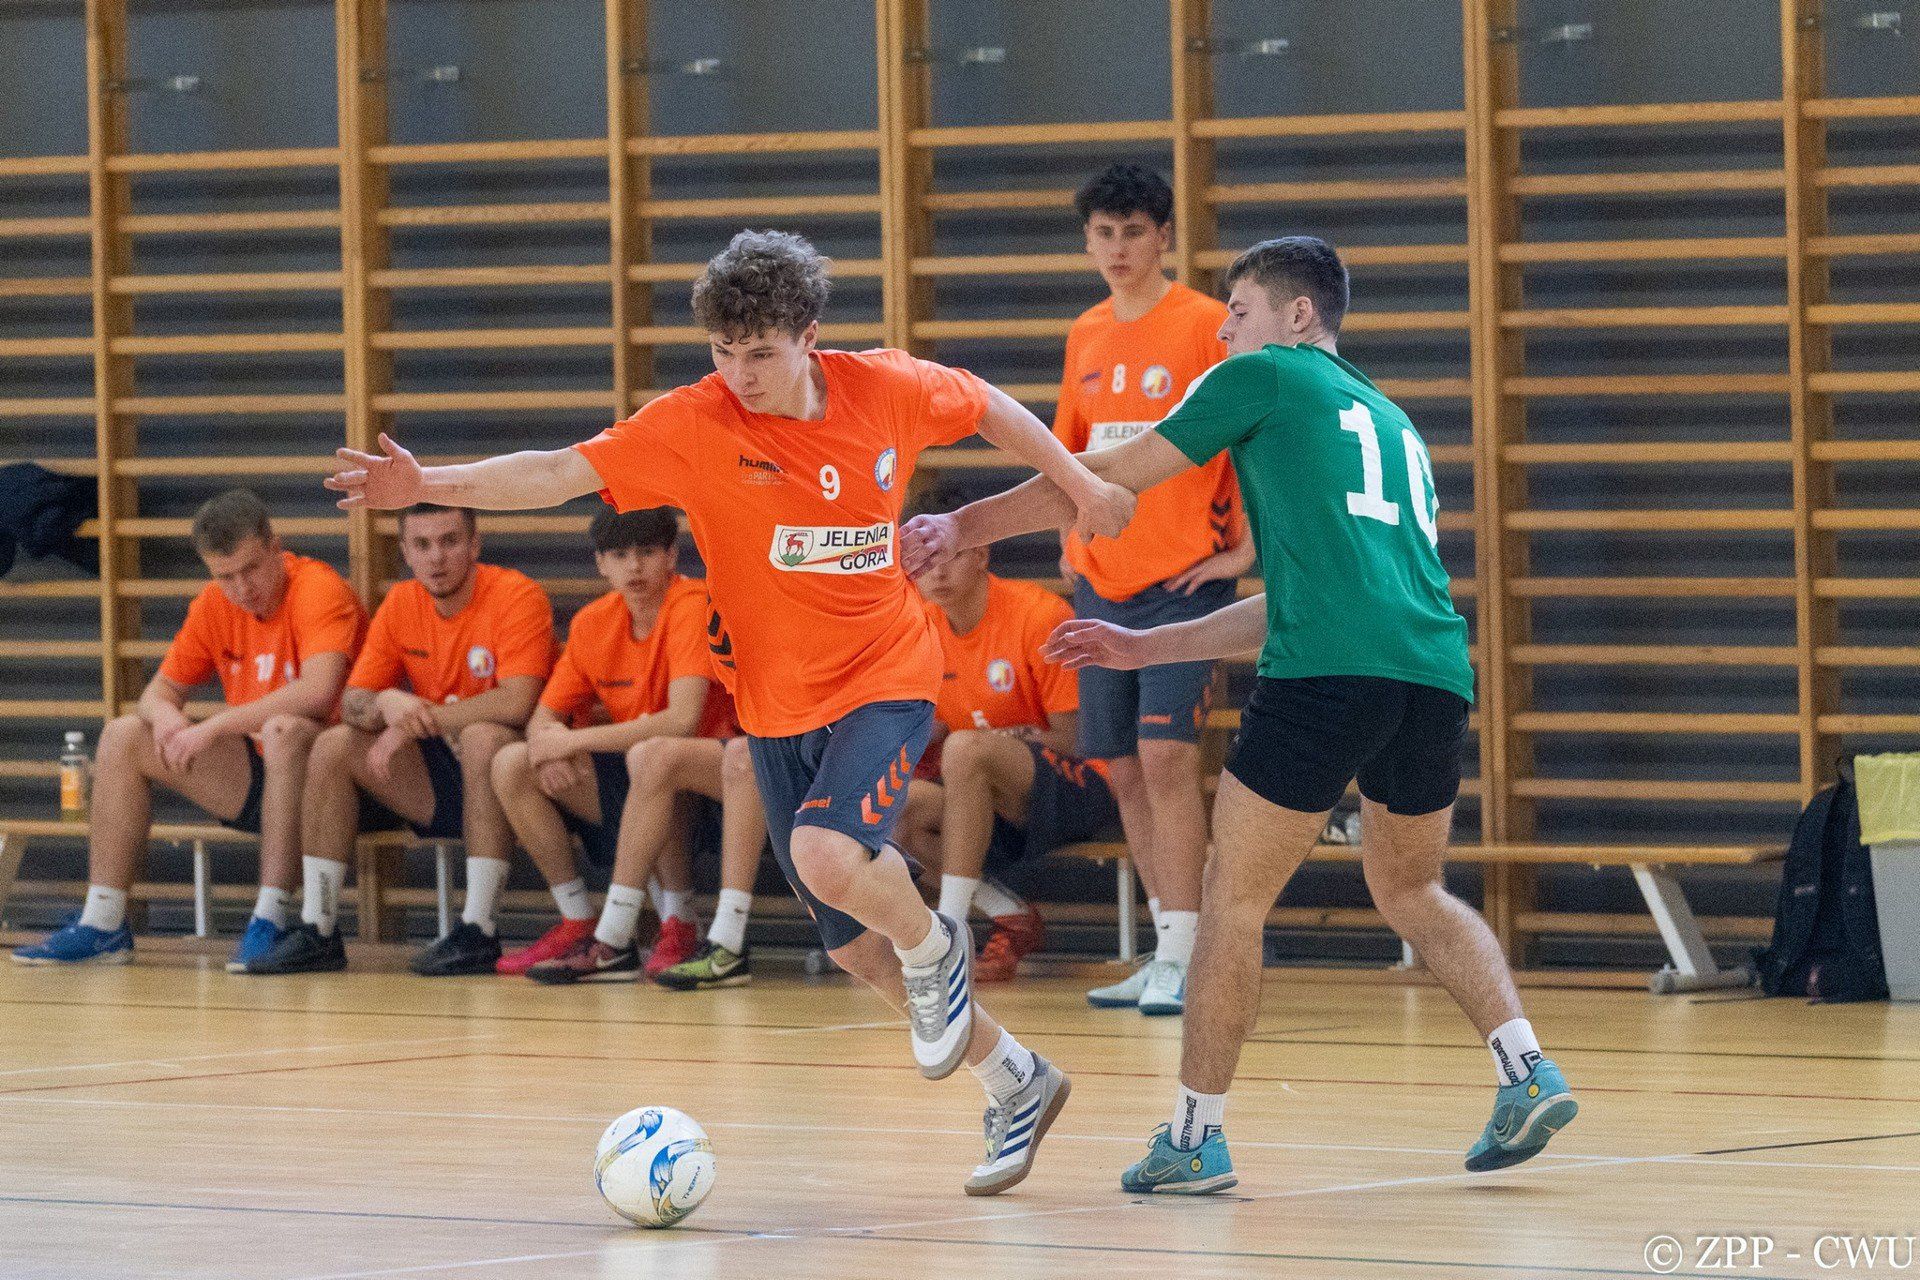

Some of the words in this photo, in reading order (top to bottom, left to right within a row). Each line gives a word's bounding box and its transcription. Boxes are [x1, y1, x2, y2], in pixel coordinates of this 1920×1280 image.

[1111, 363, 1126, 394] 8
[819, 464, 841, 501] 9
[1338, 399, 1440, 549] 10
[819, 526, 888, 548] JELENIA
[840, 547, 888, 571] GÓRA
